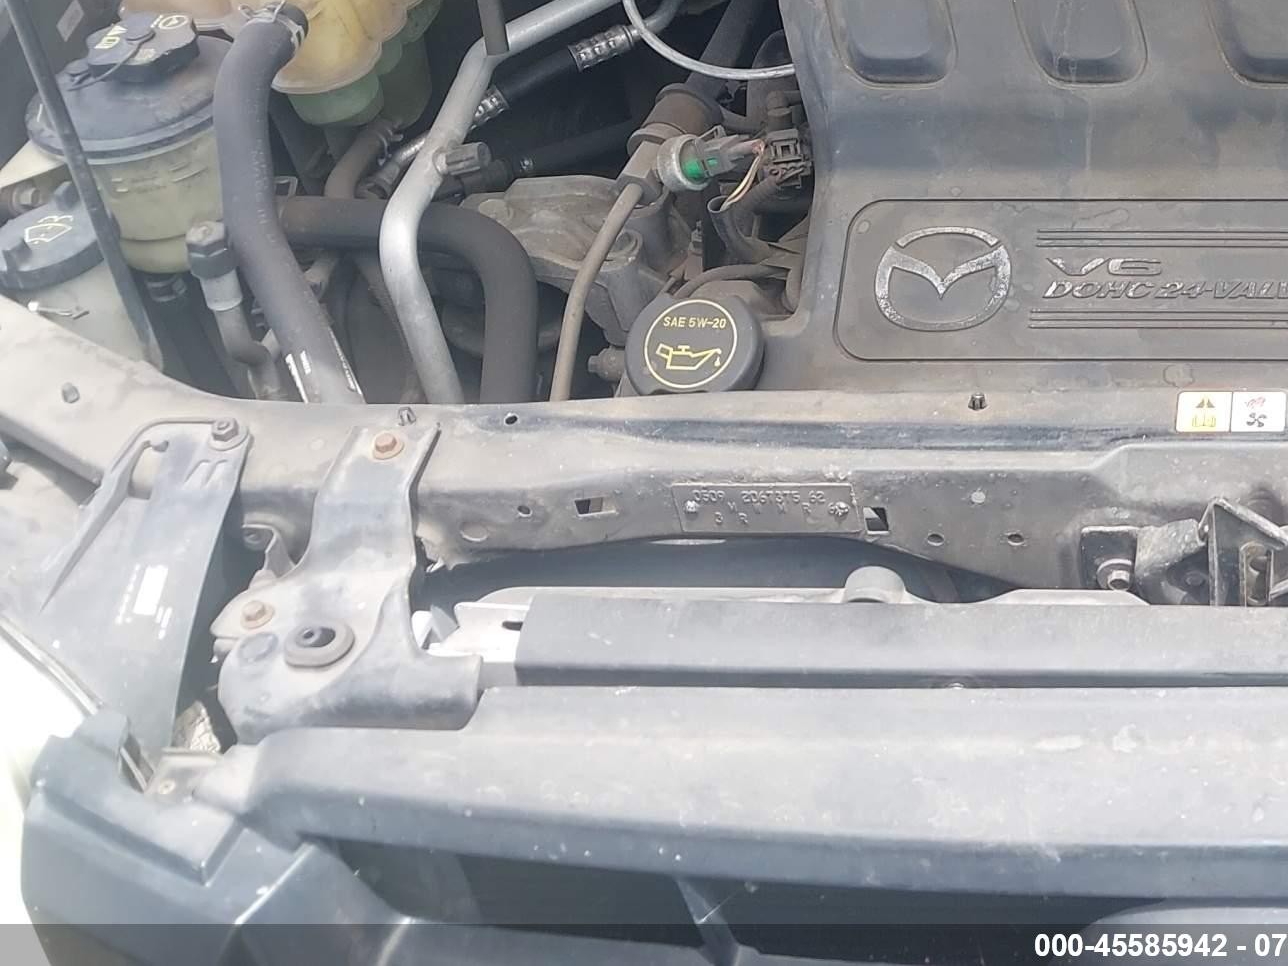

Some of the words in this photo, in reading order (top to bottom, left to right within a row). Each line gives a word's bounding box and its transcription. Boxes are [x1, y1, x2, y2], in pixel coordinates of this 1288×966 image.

[1046, 257, 1162, 276] V6
[1042, 281, 1154, 299] DOHC
[663, 316, 687, 328] SAE
[688, 317, 727, 329] 5W-20
